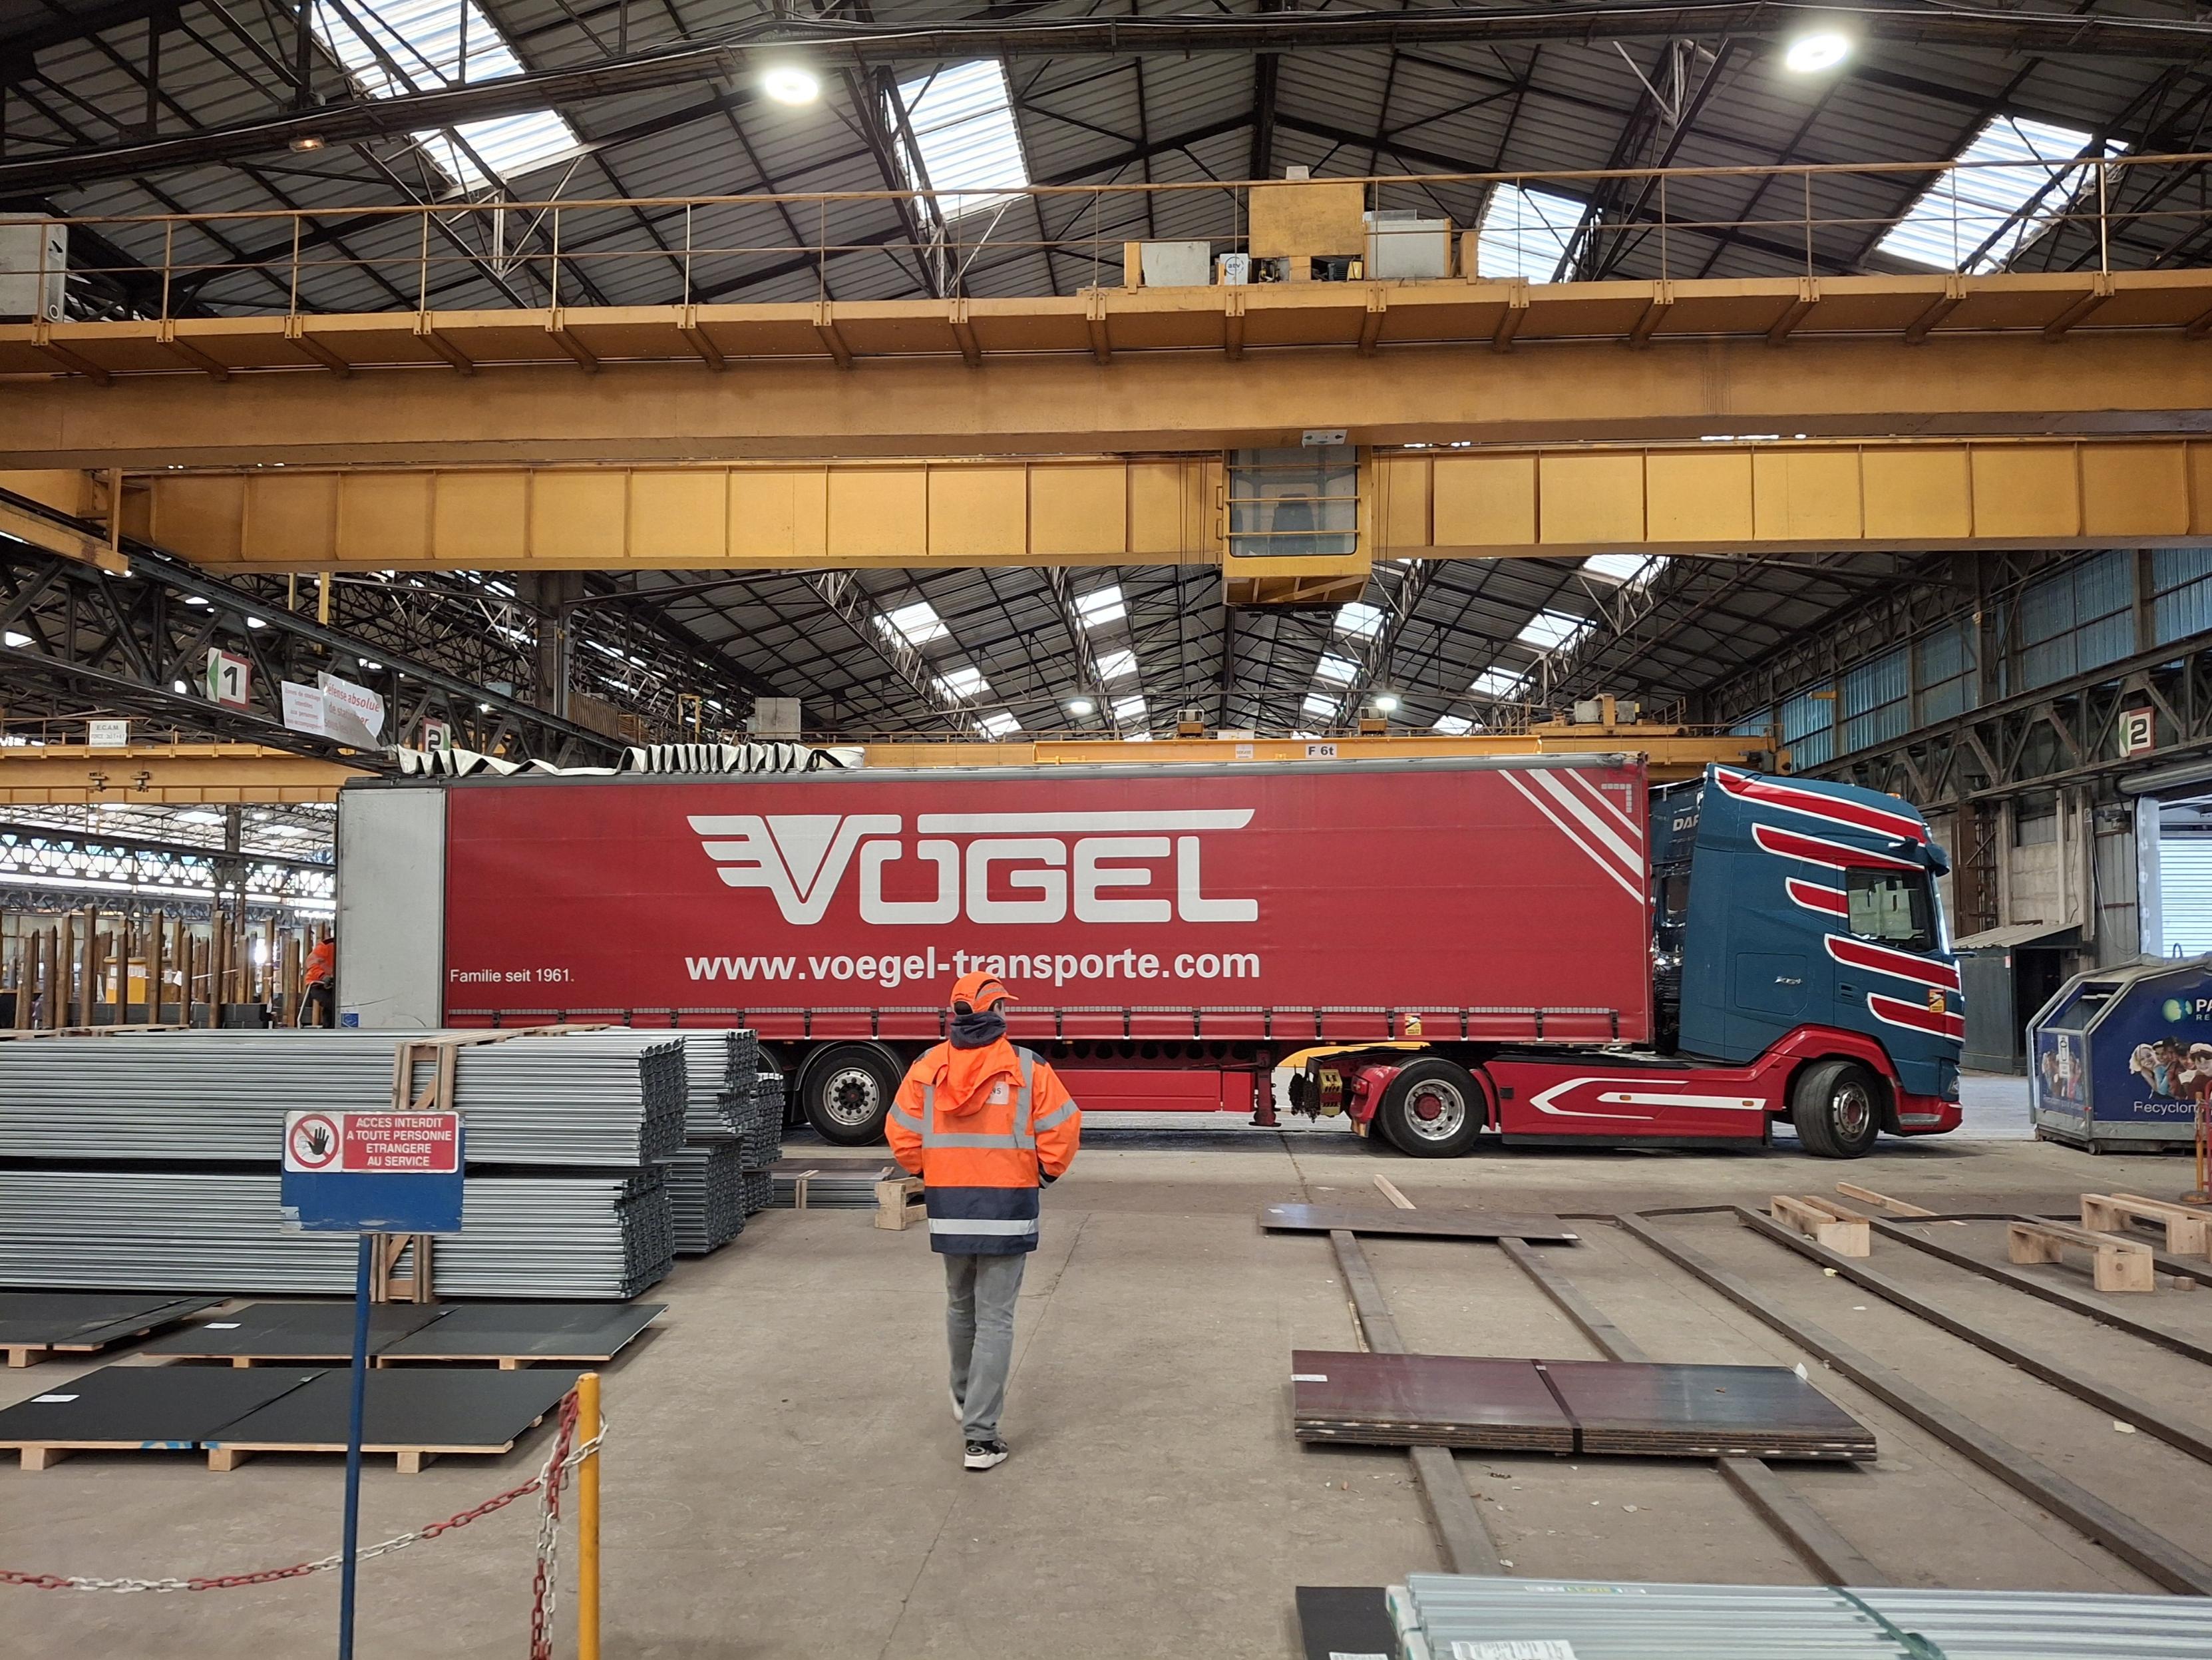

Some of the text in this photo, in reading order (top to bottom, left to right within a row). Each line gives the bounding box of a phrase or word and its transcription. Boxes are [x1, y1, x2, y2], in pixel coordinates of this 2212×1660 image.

[223, 666, 238, 696] 1
[348, 693, 380, 713] absolue
[2131, 718, 2147, 745] 2
[428, 729, 441, 752] 2
[1308, 745, 1334, 755] F 6t
[1672, 813, 1700, 832] DAF
[685, 946, 1260, 987] www.voegel-transporte.com
[450, 968, 575, 982] Familie seit 1961.
[356, 1118, 443, 1128] ACCES INTERDIT
[346, 1130, 453, 1141] A TOUTE PERSONNE
[366, 1143, 432, 1153] ETRANGERE
[367, 1155, 430, 1166] AU SERVICE
